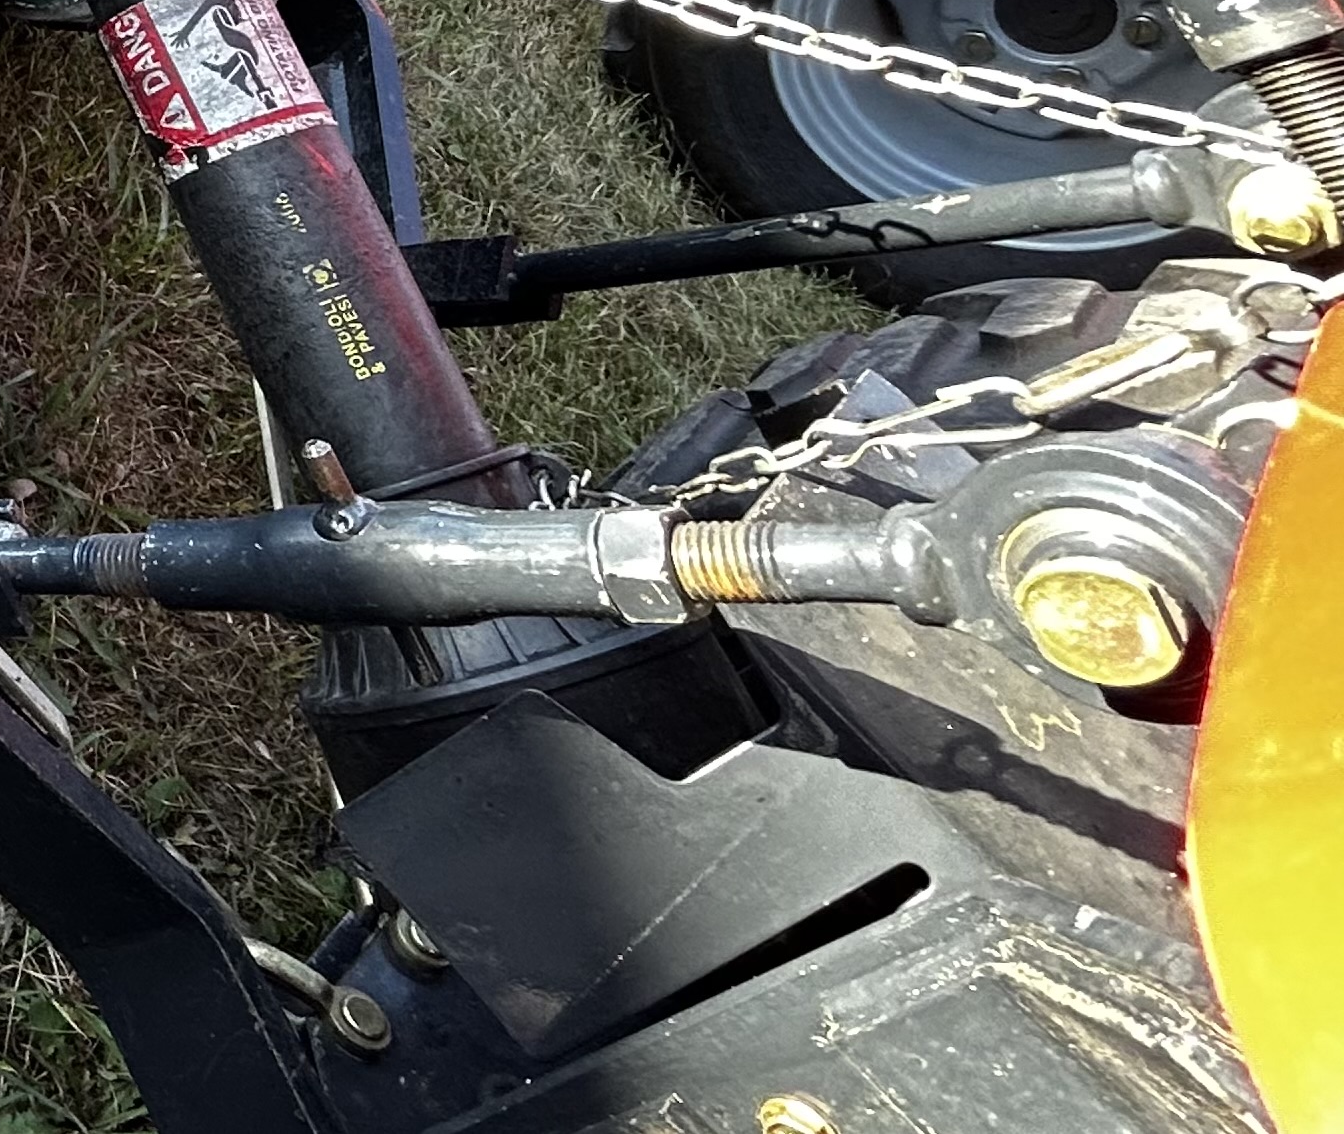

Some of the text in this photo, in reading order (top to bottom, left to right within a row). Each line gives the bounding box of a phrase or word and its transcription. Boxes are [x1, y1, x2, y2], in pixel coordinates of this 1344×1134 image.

[257, 19, 303, 92] ROTATING
[318, 298, 371, 381] BONDIOLI
[335, 294, 386, 374] & PAVESI
